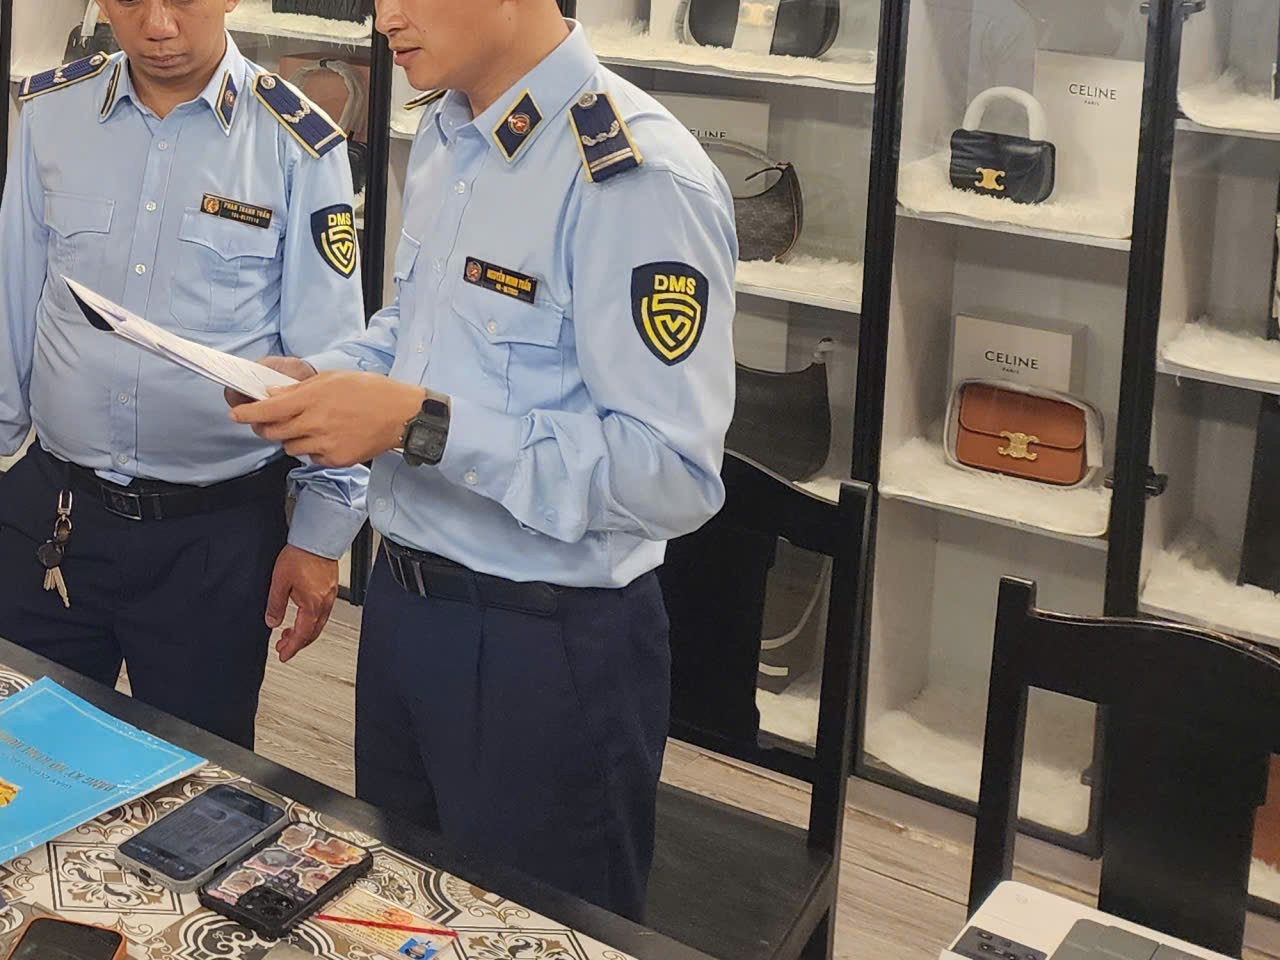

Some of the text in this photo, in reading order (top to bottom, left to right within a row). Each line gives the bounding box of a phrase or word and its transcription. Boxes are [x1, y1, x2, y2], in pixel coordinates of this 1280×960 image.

[1068, 83, 1118, 100] CELINE
[689, 129, 727, 139] ELINE
[327, 212, 352, 227] DMS
[654, 274, 696, 295] DMS
[984, 350, 1039, 370] CELINE
